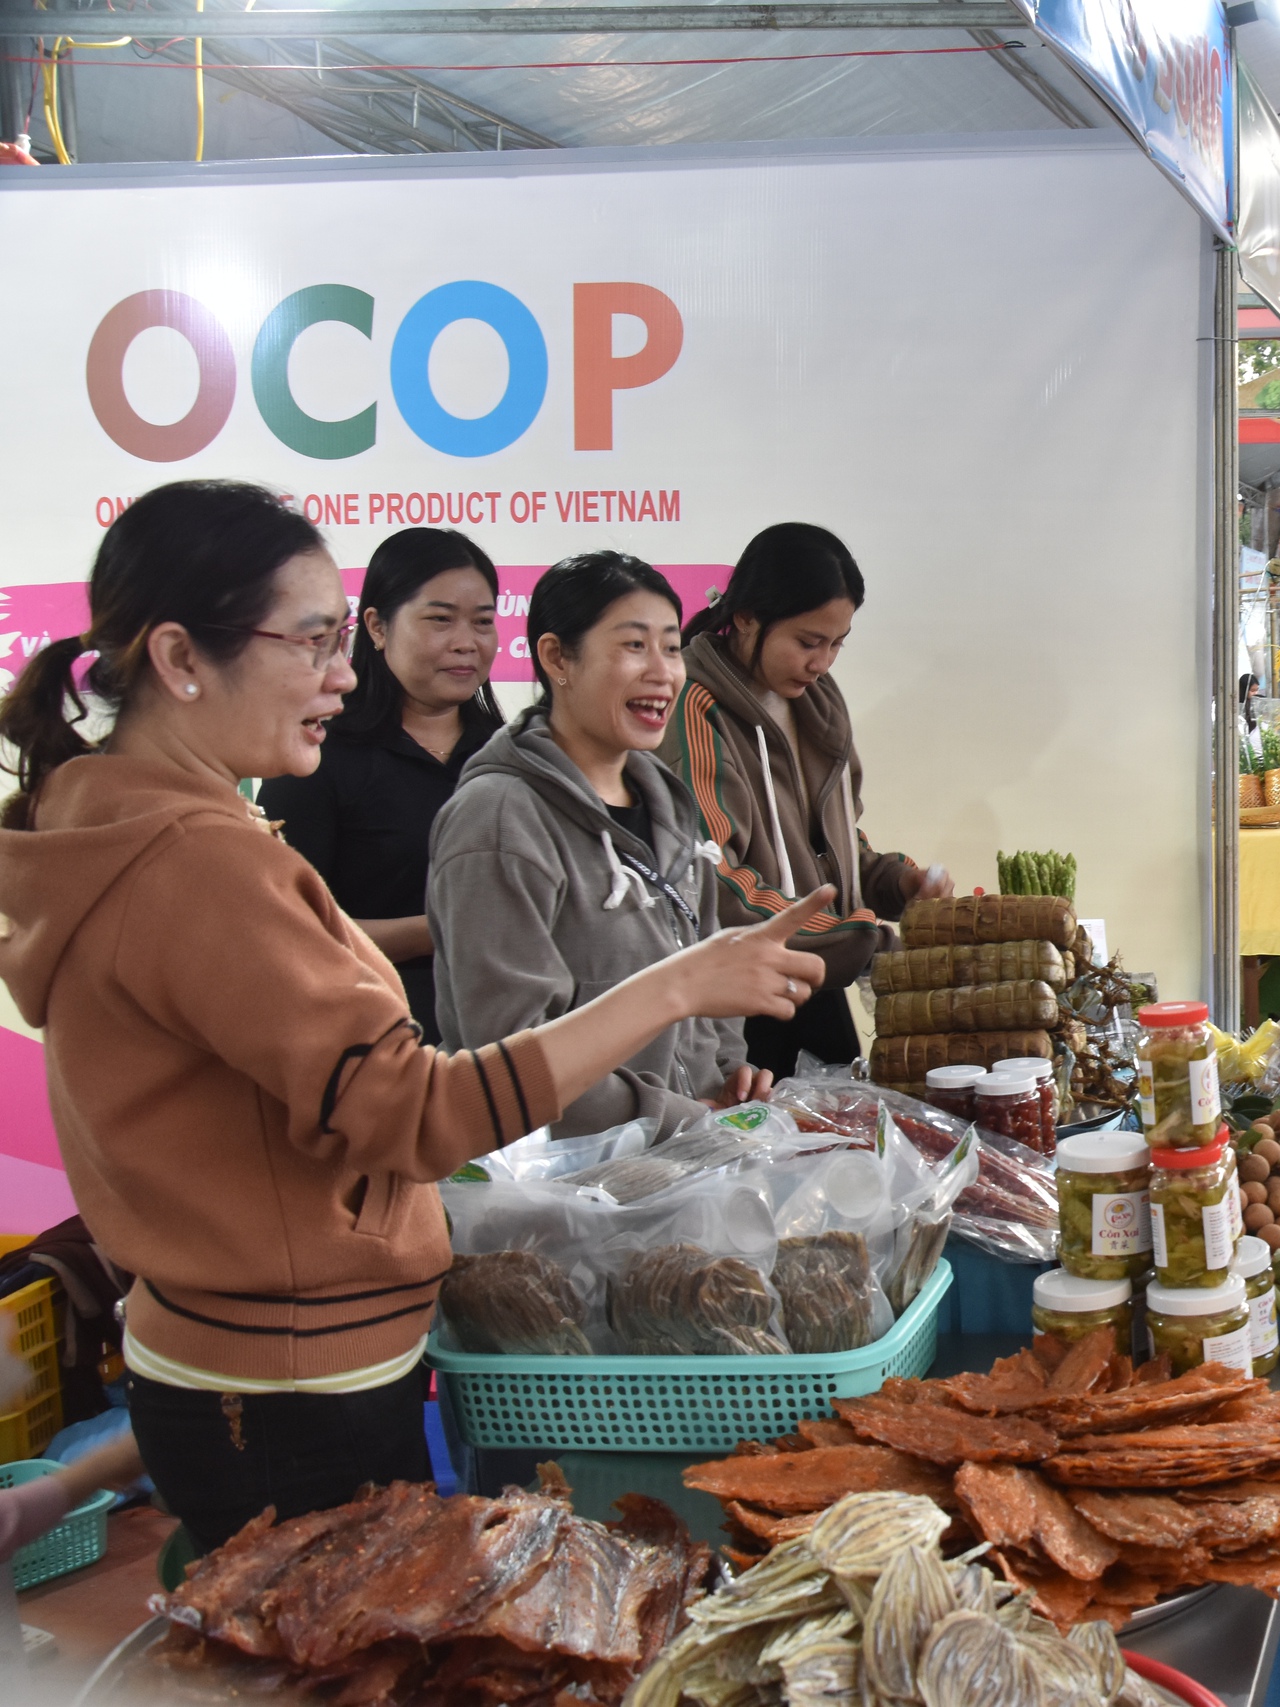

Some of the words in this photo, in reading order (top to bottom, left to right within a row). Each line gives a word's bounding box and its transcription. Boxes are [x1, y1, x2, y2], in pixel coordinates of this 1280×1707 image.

[86, 280, 684, 462] OCOP
[303, 494, 360, 526] ONE
[369, 491, 501, 525] PRODUCT
[510, 490, 547, 523] OF
[556, 489, 681, 523] VIETNAM
